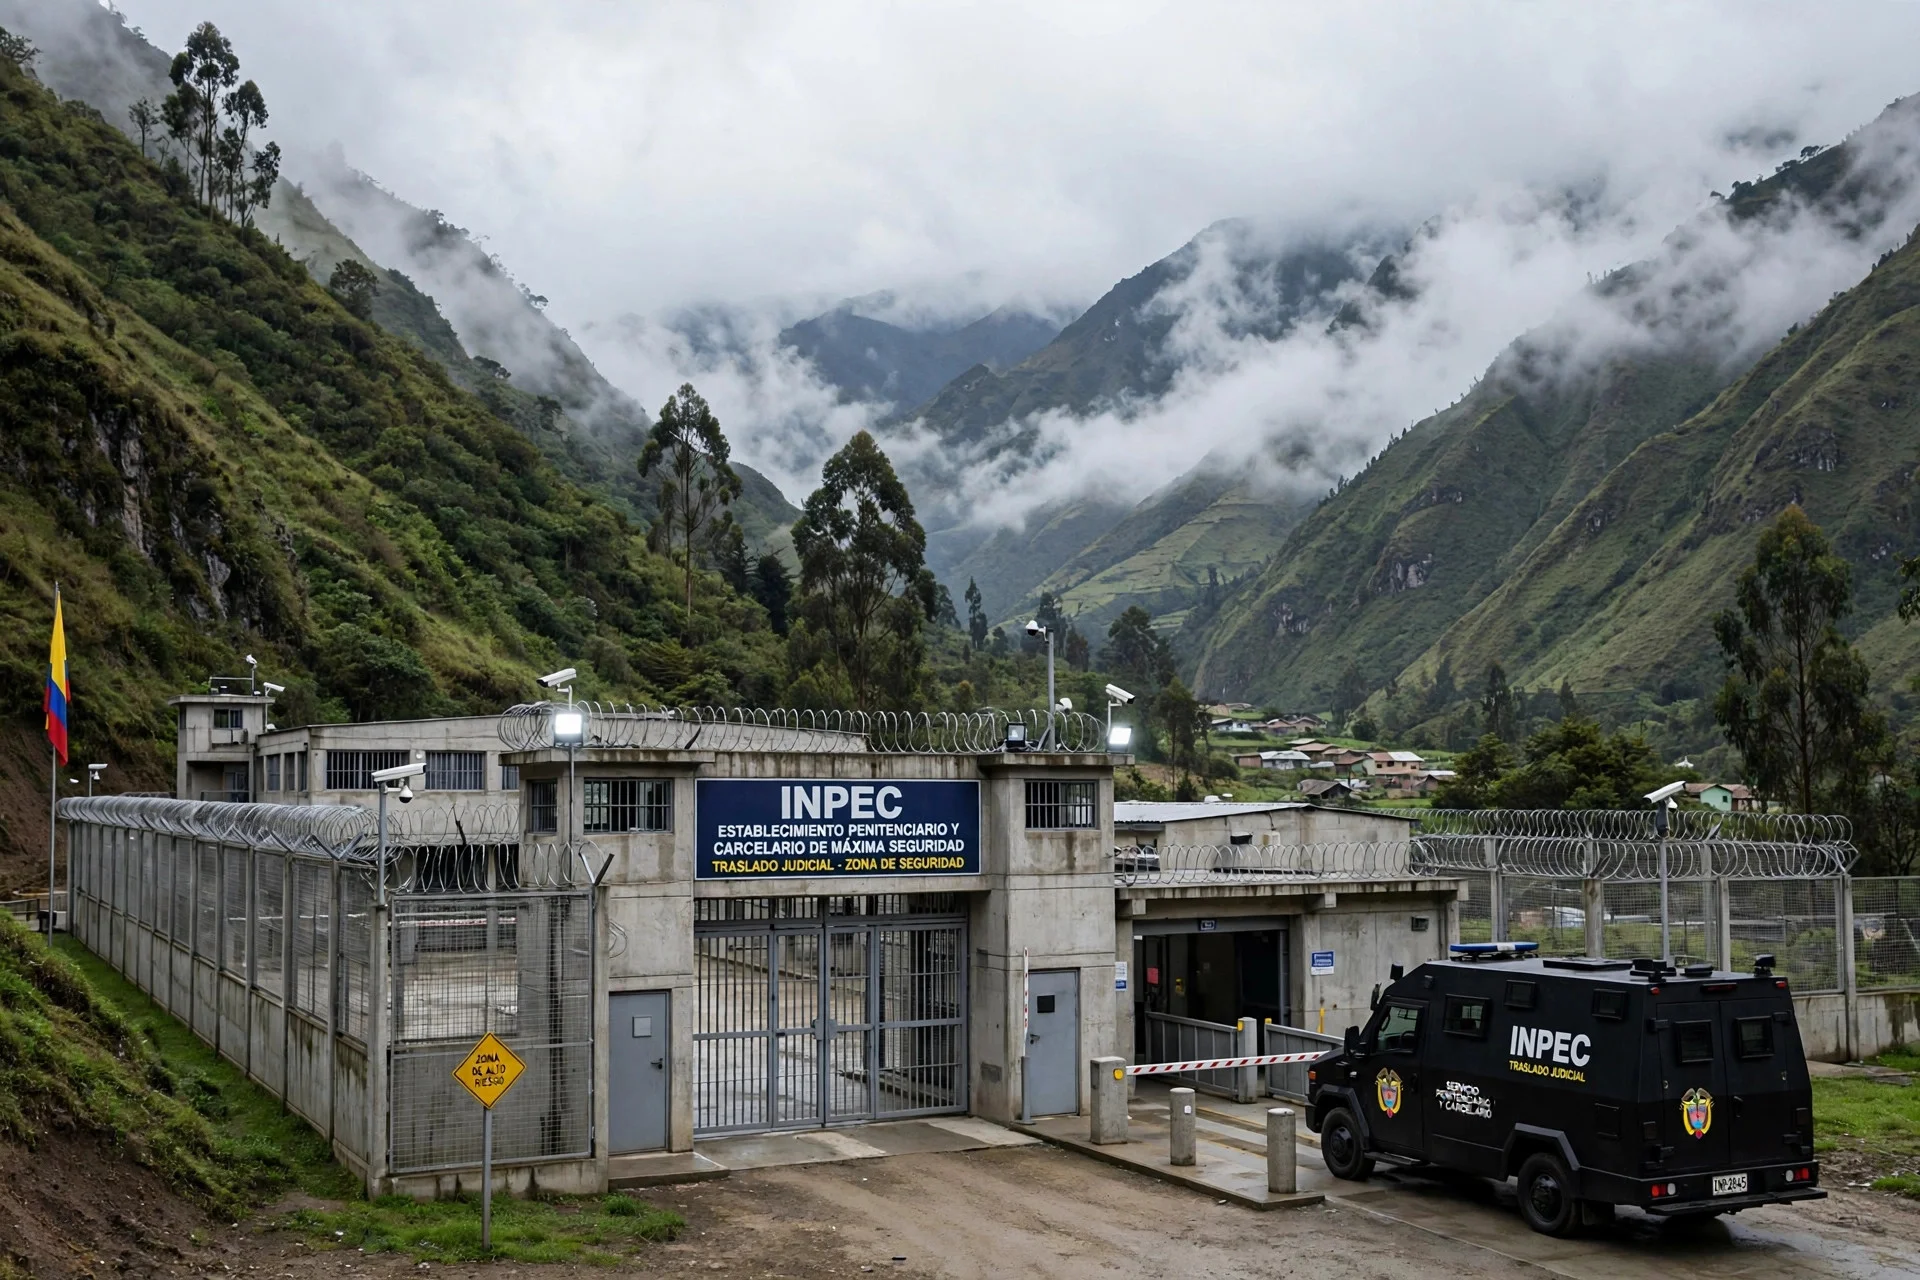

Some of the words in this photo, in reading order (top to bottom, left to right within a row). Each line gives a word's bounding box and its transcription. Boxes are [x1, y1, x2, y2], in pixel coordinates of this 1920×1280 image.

[781, 785, 903, 819] INPEC
[718, 824, 844, 838] ESTABLECIMIENTO
[848, 823, 948, 836] PENITENCIARIO
[951, 823, 960, 836] Y
[713, 841, 806, 855] CARCELARIO
[809, 841, 828, 854] DE
[831, 837, 885, 854] MÁXIMA
[888, 839, 965, 853] SEGURIDAD
[712, 860, 779, 873] TRASLADO
[781, 859, 834, 871] JUDICIAL
[845, 858, 878, 870] ZONA
[880, 858, 896, 870] DE
[899, 857, 965, 869] SEGURIDAD
[1510, 1025, 1592, 1067] INPEC
[475, 1053, 501, 1064] ZONA
[472, 1066, 483, 1076] DE
[1509, 1060, 1549, 1076] TRASLADO
[1550, 1067, 1586, 1082] JUDICIAL
